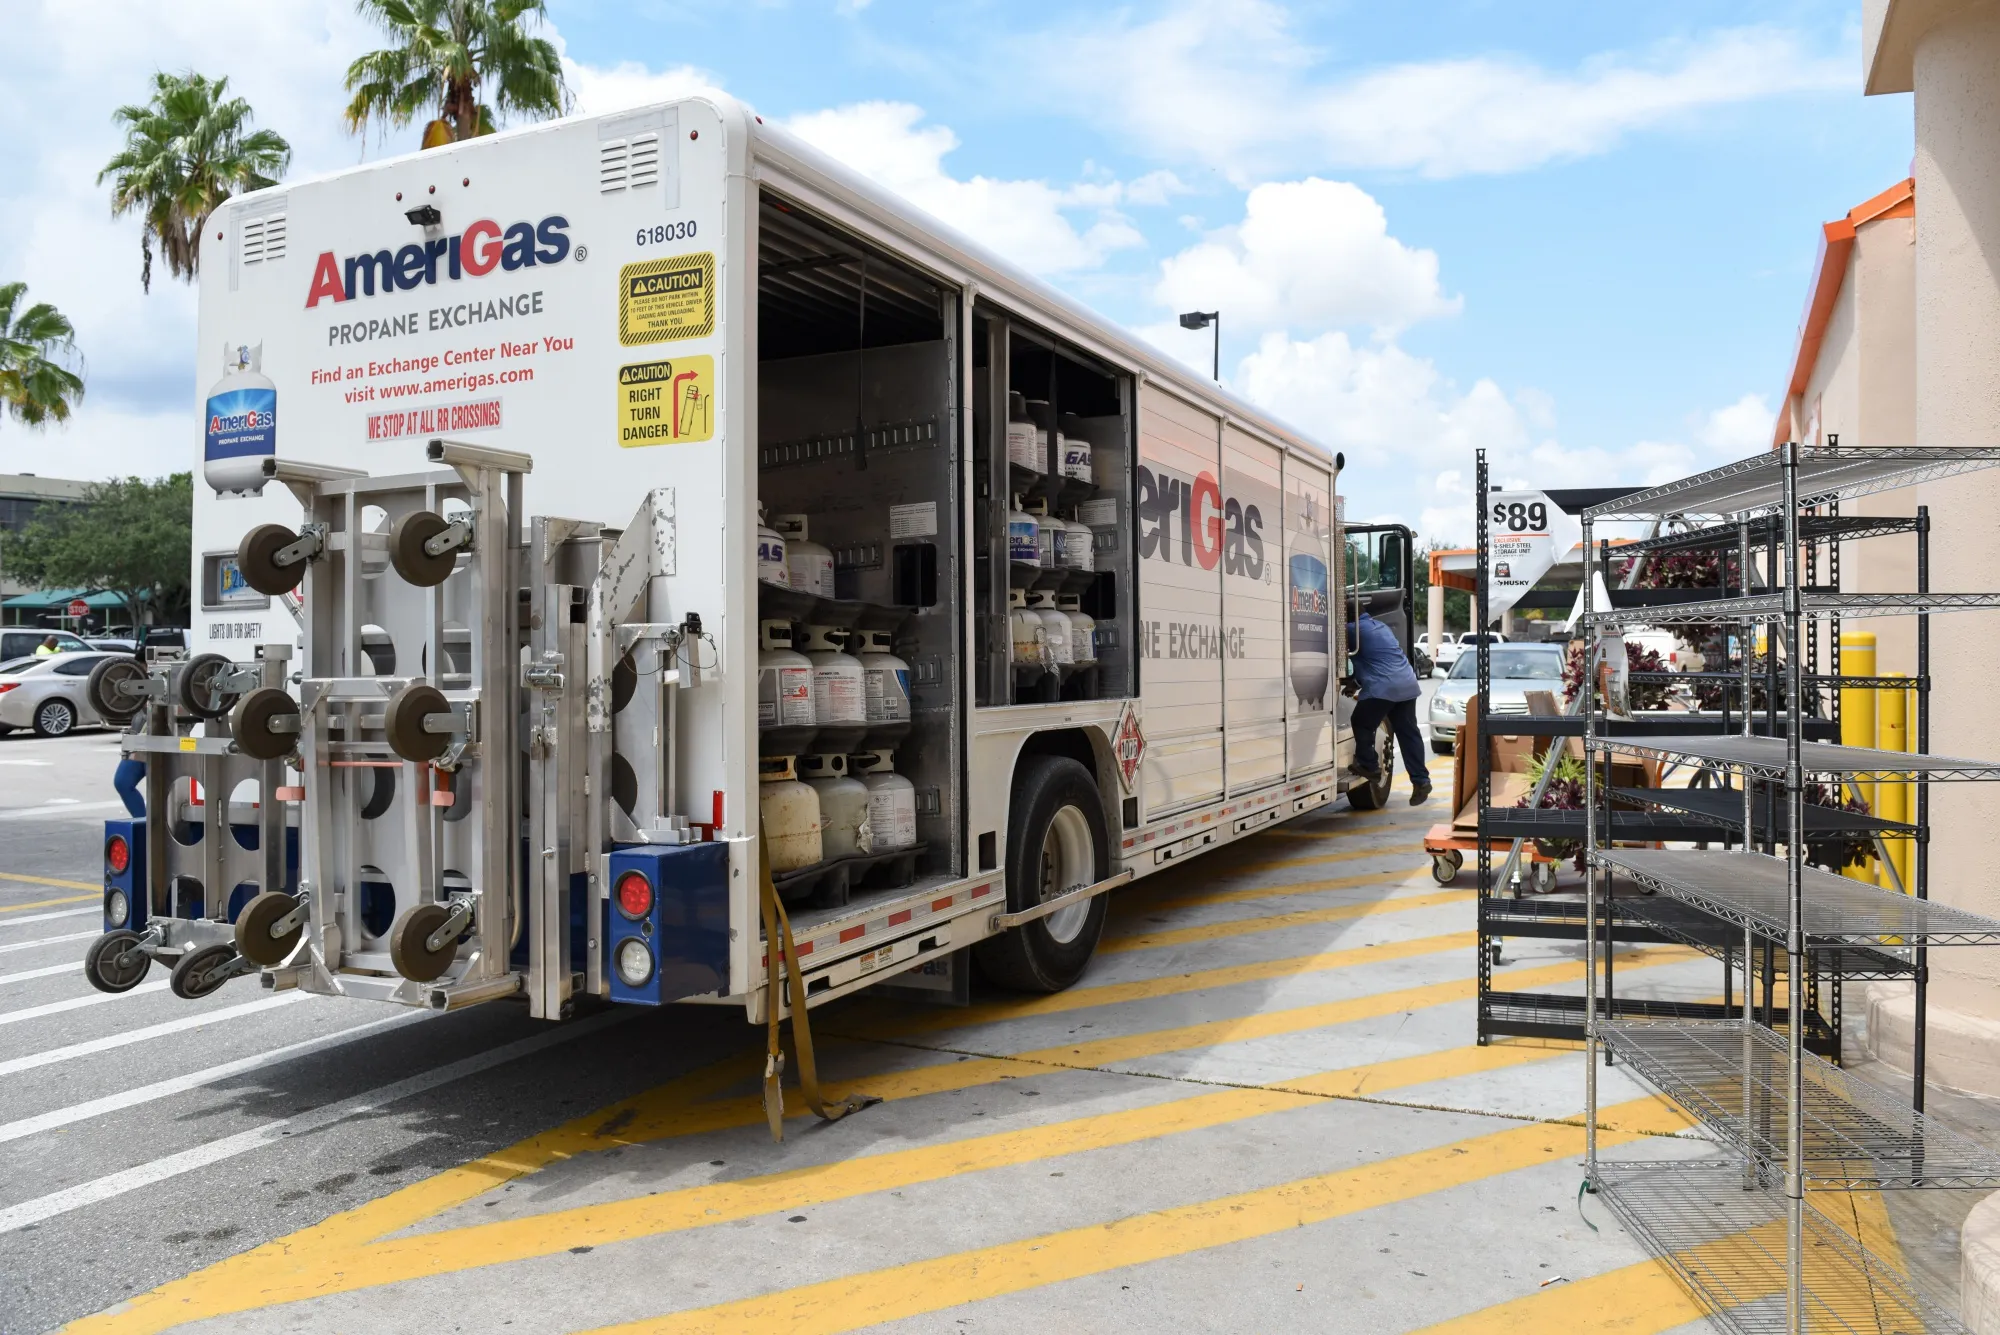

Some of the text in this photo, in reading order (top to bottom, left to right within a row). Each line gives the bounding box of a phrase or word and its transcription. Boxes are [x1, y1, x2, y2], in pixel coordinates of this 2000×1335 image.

[636, 220, 697, 246] 618030
[305, 215, 571, 309] AmeriGas
[647, 272, 699, 293] CAUTION
[634, 298, 650, 306] PLEASE
[686, 298, 702, 306] DRIVER
[328, 291, 543, 346] PROPANE EXCHANGE
[636, 312, 656, 320] LOADING
[648, 319, 669, 329] THANK
[311, 336, 574, 385] Find an Exchange Center Near You
[631, 364, 670, 382] CAUTION
[344, 368, 534, 403] visit www.amerigas.com
[629, 387, 662, 403] RIGHT
[209, 410, 272, 434] AmeriGas
[368, 400, 500, 439] WE STOP AT ALL RR CROSSINGS
[630, 406, 660, 421] TURN
[218, 434, 264, 445] PROPANE EXCHANGE
[623, 424, 668, 440] DANGER
[1138, 465, 1264, 580] eriGas
[1493, 502, 1547, 531] $89
[69, 605, 89, 614] STOP
[1292, 586, 1326, 615] AmeriGas
[209, 622, 262, 639] LIGHTS ON FOR SAFETY
[1169, 623, 1244, 659] EXCHANGE
